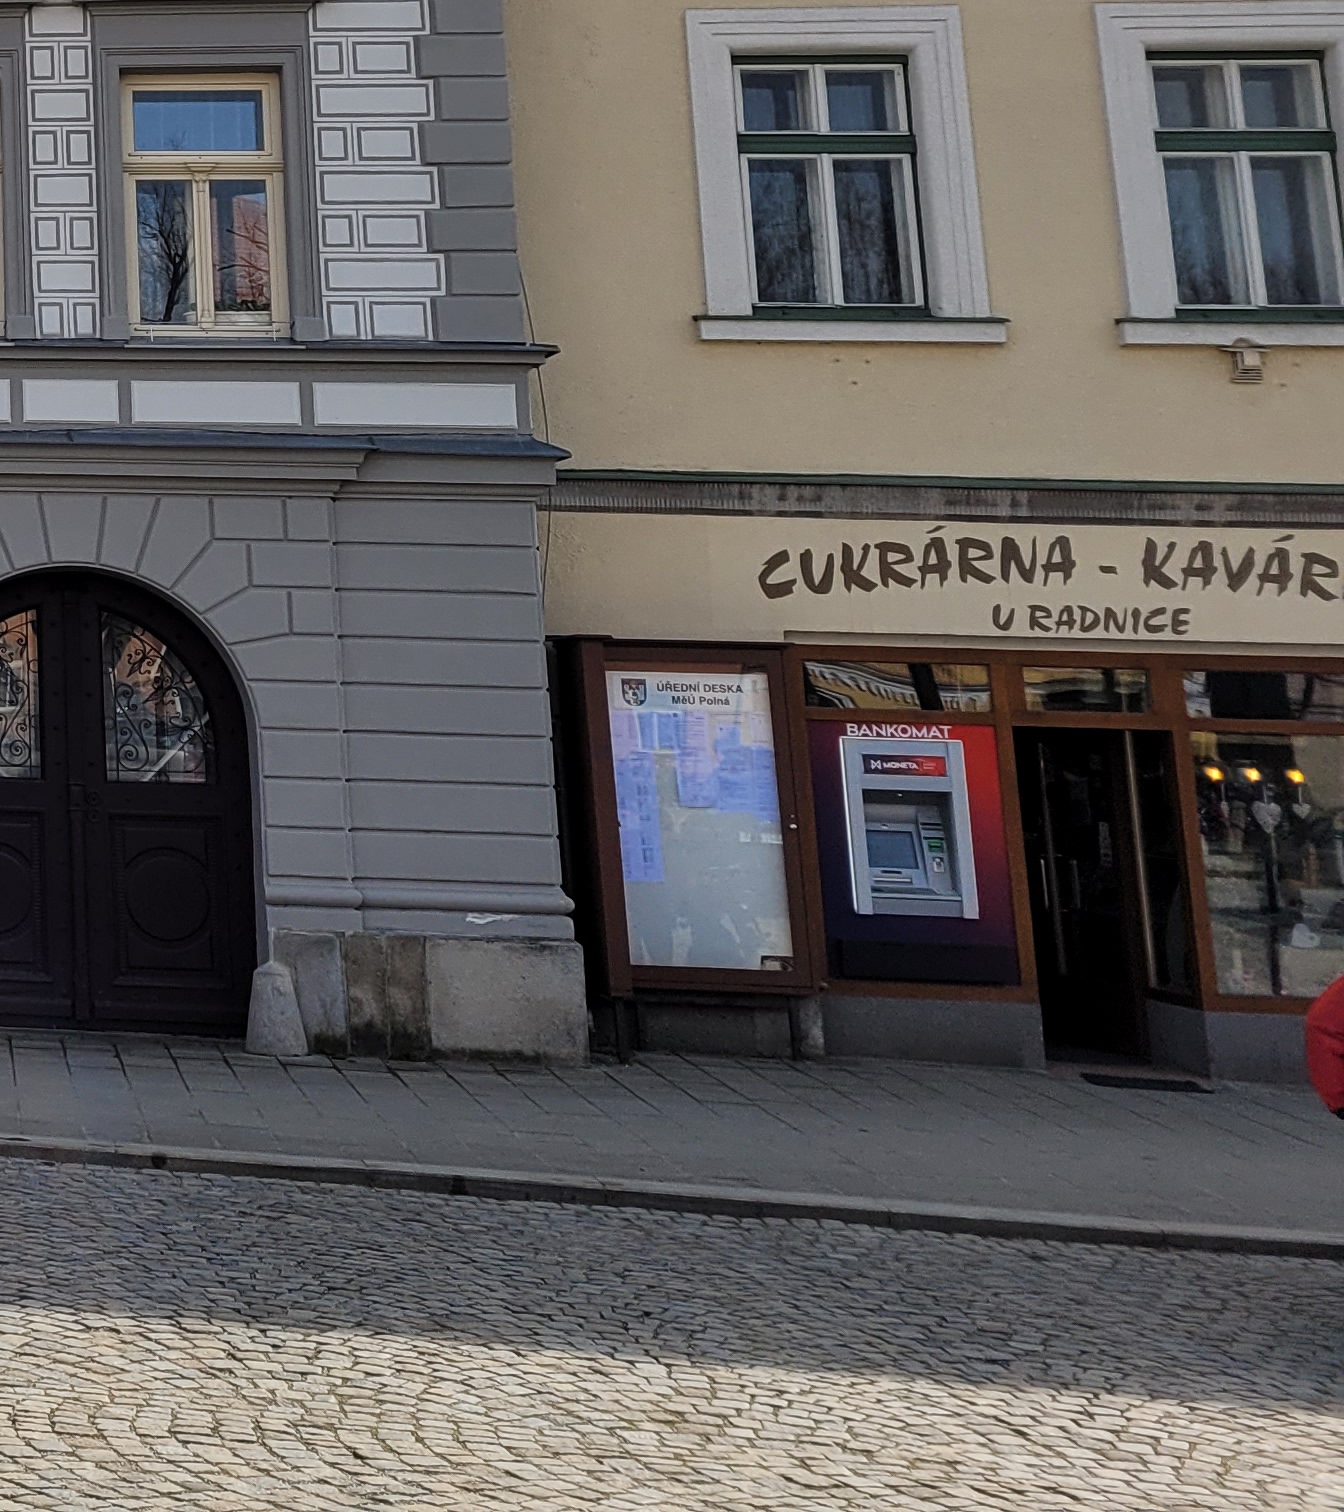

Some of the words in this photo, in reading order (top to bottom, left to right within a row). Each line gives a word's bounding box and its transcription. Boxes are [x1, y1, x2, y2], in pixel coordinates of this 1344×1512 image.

[758, 525, 1077, 599] CUKRÁRNA
[1141, 534, 1344, 602] KAVÁR
[992, 603, 1016, 631] U
[1028, 604, 1192, 636] RADNICE
[656, 680, 700, 693] ÚŘEDNÍ
[703, 684, 744, 694] DESKA
[671, 694, 696, 705] MěÚ
[699, 696, 730, 706] Polná
[846, 723, 953, 739] BANKOMAT
[883, 761, 920, 770] MONETA
